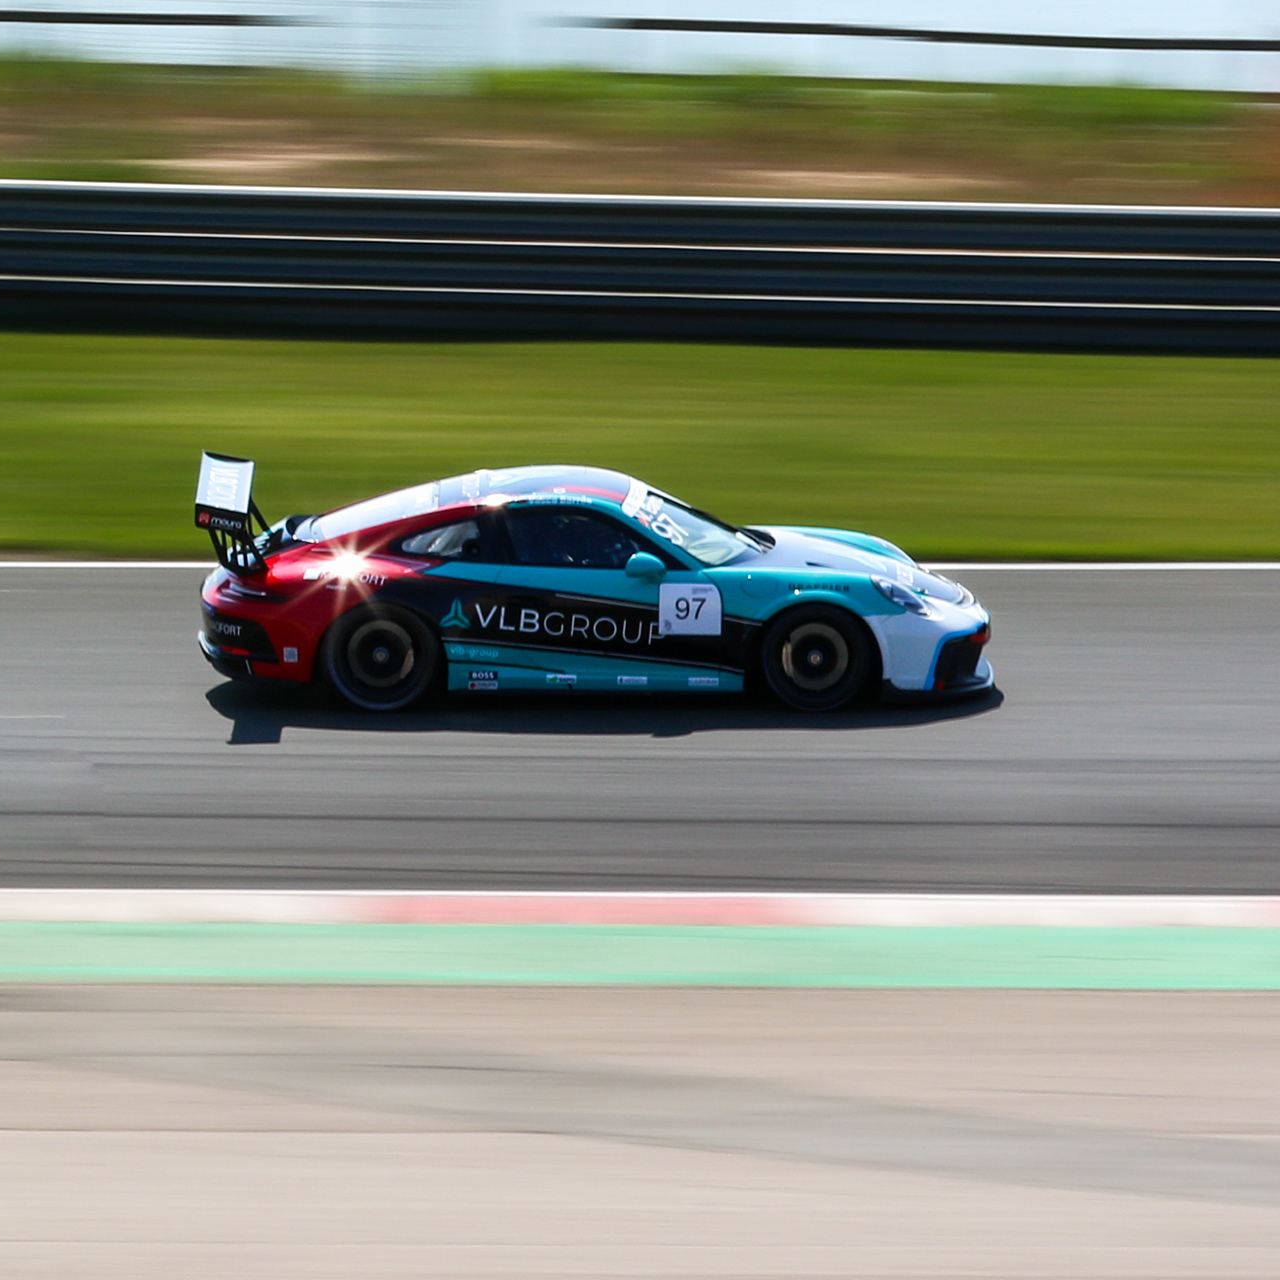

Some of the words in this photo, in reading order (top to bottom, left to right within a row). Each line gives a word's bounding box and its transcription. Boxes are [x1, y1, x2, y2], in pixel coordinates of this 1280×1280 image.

[651, 513, 689, 546] 97
[475, 603, 666, 645] VLBGROUP
[675, 597, 706, 620] 97
